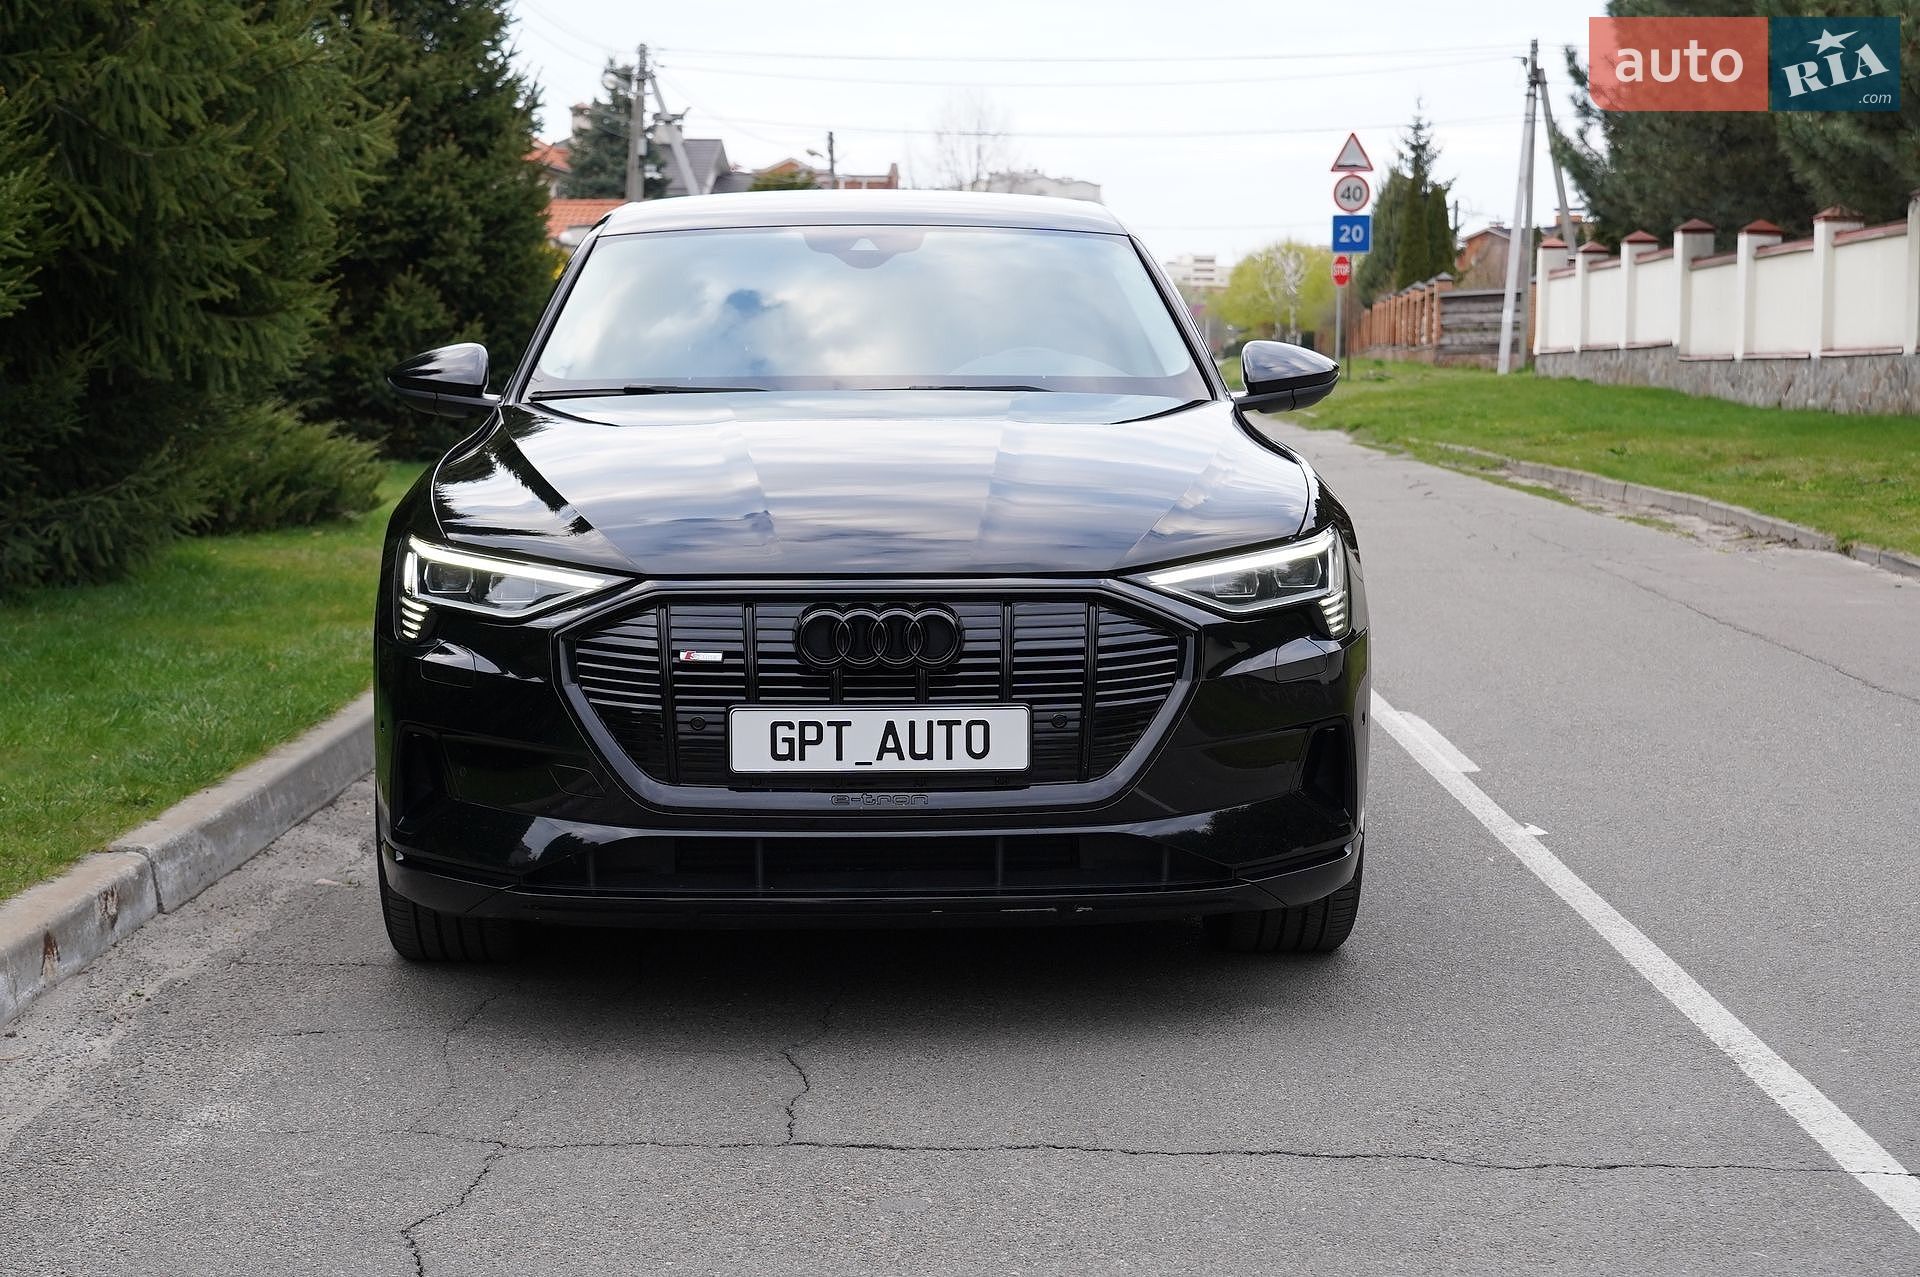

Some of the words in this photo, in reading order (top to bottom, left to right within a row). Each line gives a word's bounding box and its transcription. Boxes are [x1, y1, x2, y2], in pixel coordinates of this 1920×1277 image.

[1340, 186, 1363, 202] 40
[1339, 224, 1364, 243] 20
[769, 719, 991, 766] GPT_AUTO
[831, 792, 929, 806] e-tron
